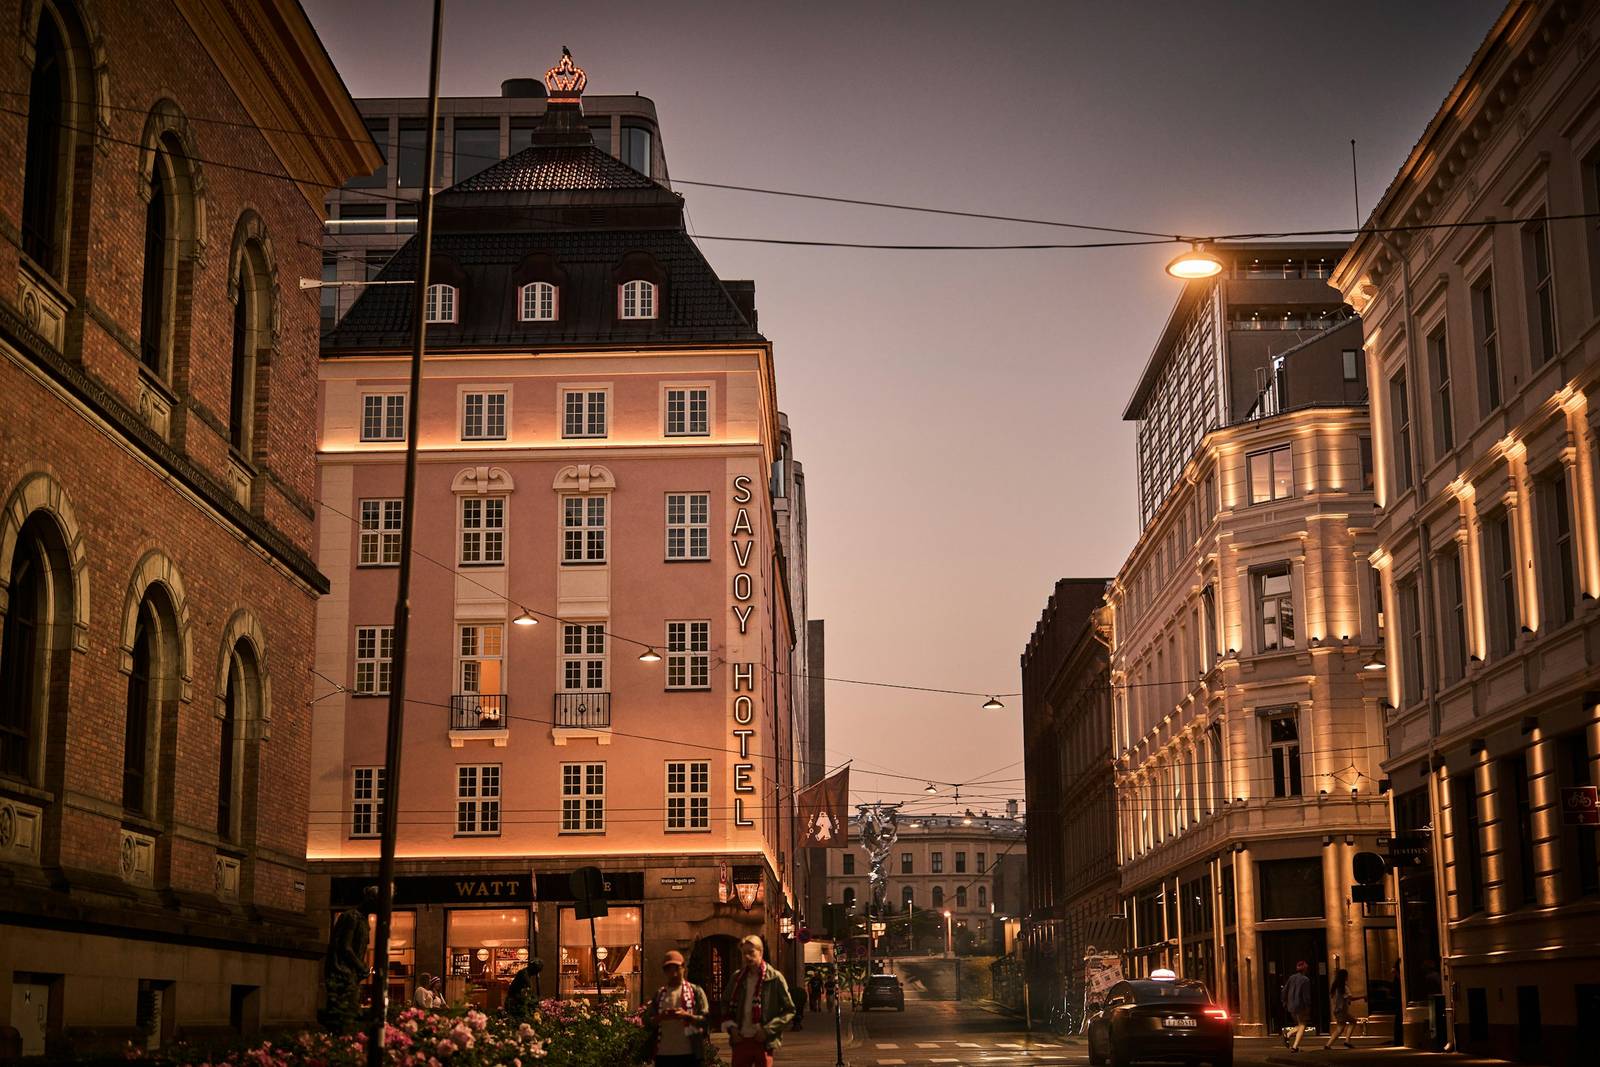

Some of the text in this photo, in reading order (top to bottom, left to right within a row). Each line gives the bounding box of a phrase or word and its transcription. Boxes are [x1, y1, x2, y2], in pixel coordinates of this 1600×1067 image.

[731, 475, 755, 827] SAVOY HOTEL
[455, 881, 520, 897] WATT
